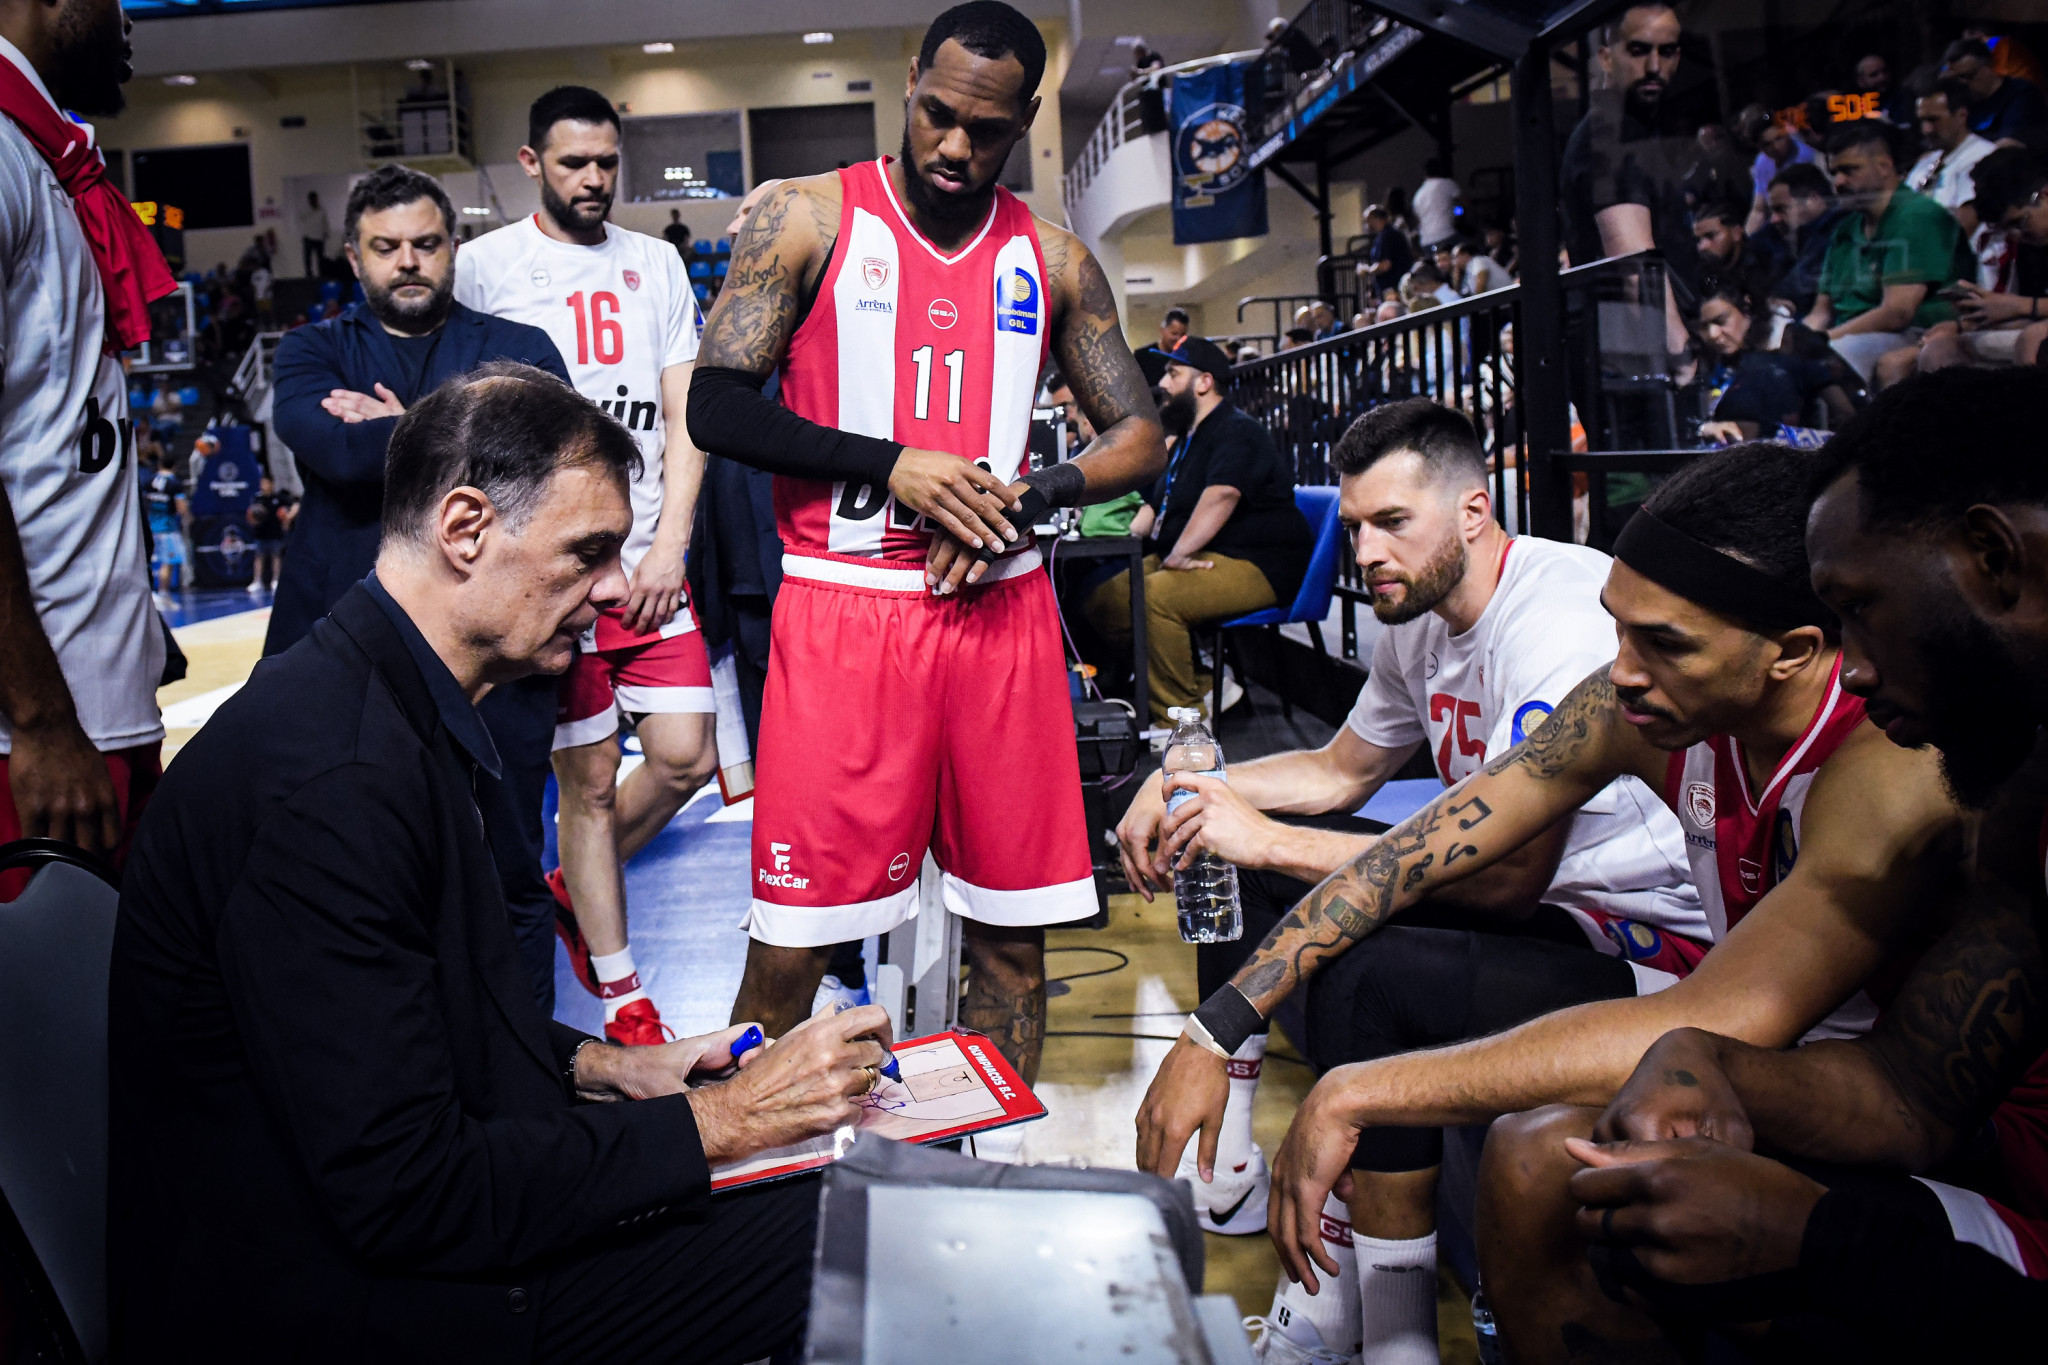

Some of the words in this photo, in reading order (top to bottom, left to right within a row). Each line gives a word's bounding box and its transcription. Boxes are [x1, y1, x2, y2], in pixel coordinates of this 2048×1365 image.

[566, 290, 624, 366] 16
[1008, 318, 1027, 330] GBL
[911, 344, 965, 424] 11
[759, 868, 810, 890] FlexCar
[967, 1044, 1007, 1087] OLYMPIACOS
